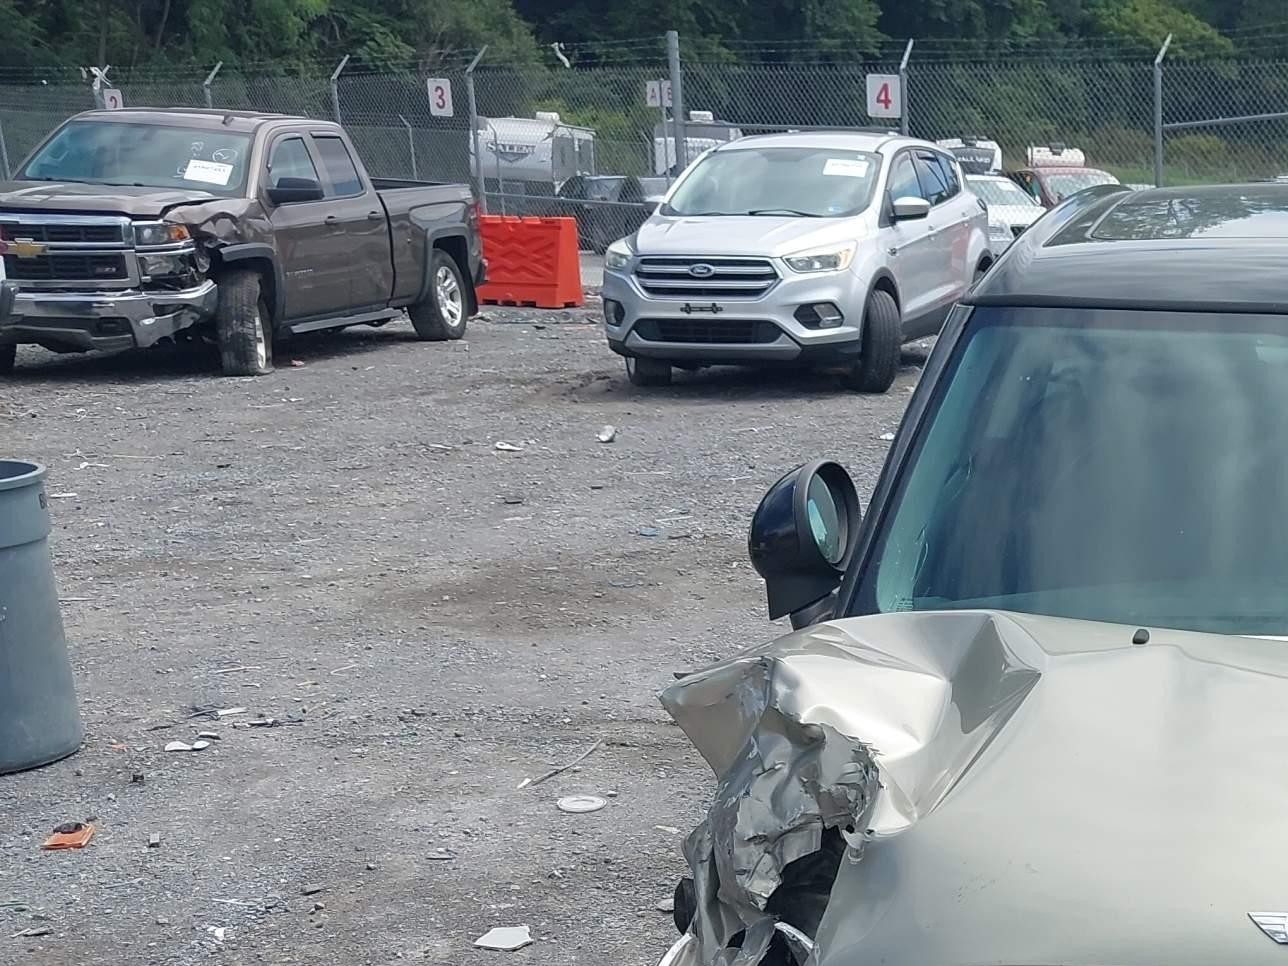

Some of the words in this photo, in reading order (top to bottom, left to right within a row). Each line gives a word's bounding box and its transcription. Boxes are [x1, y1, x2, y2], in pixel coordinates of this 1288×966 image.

[434, 86, 446, 110] 3
[650, 87, 657, 99] A
[876, 83, 891, 109] 4
